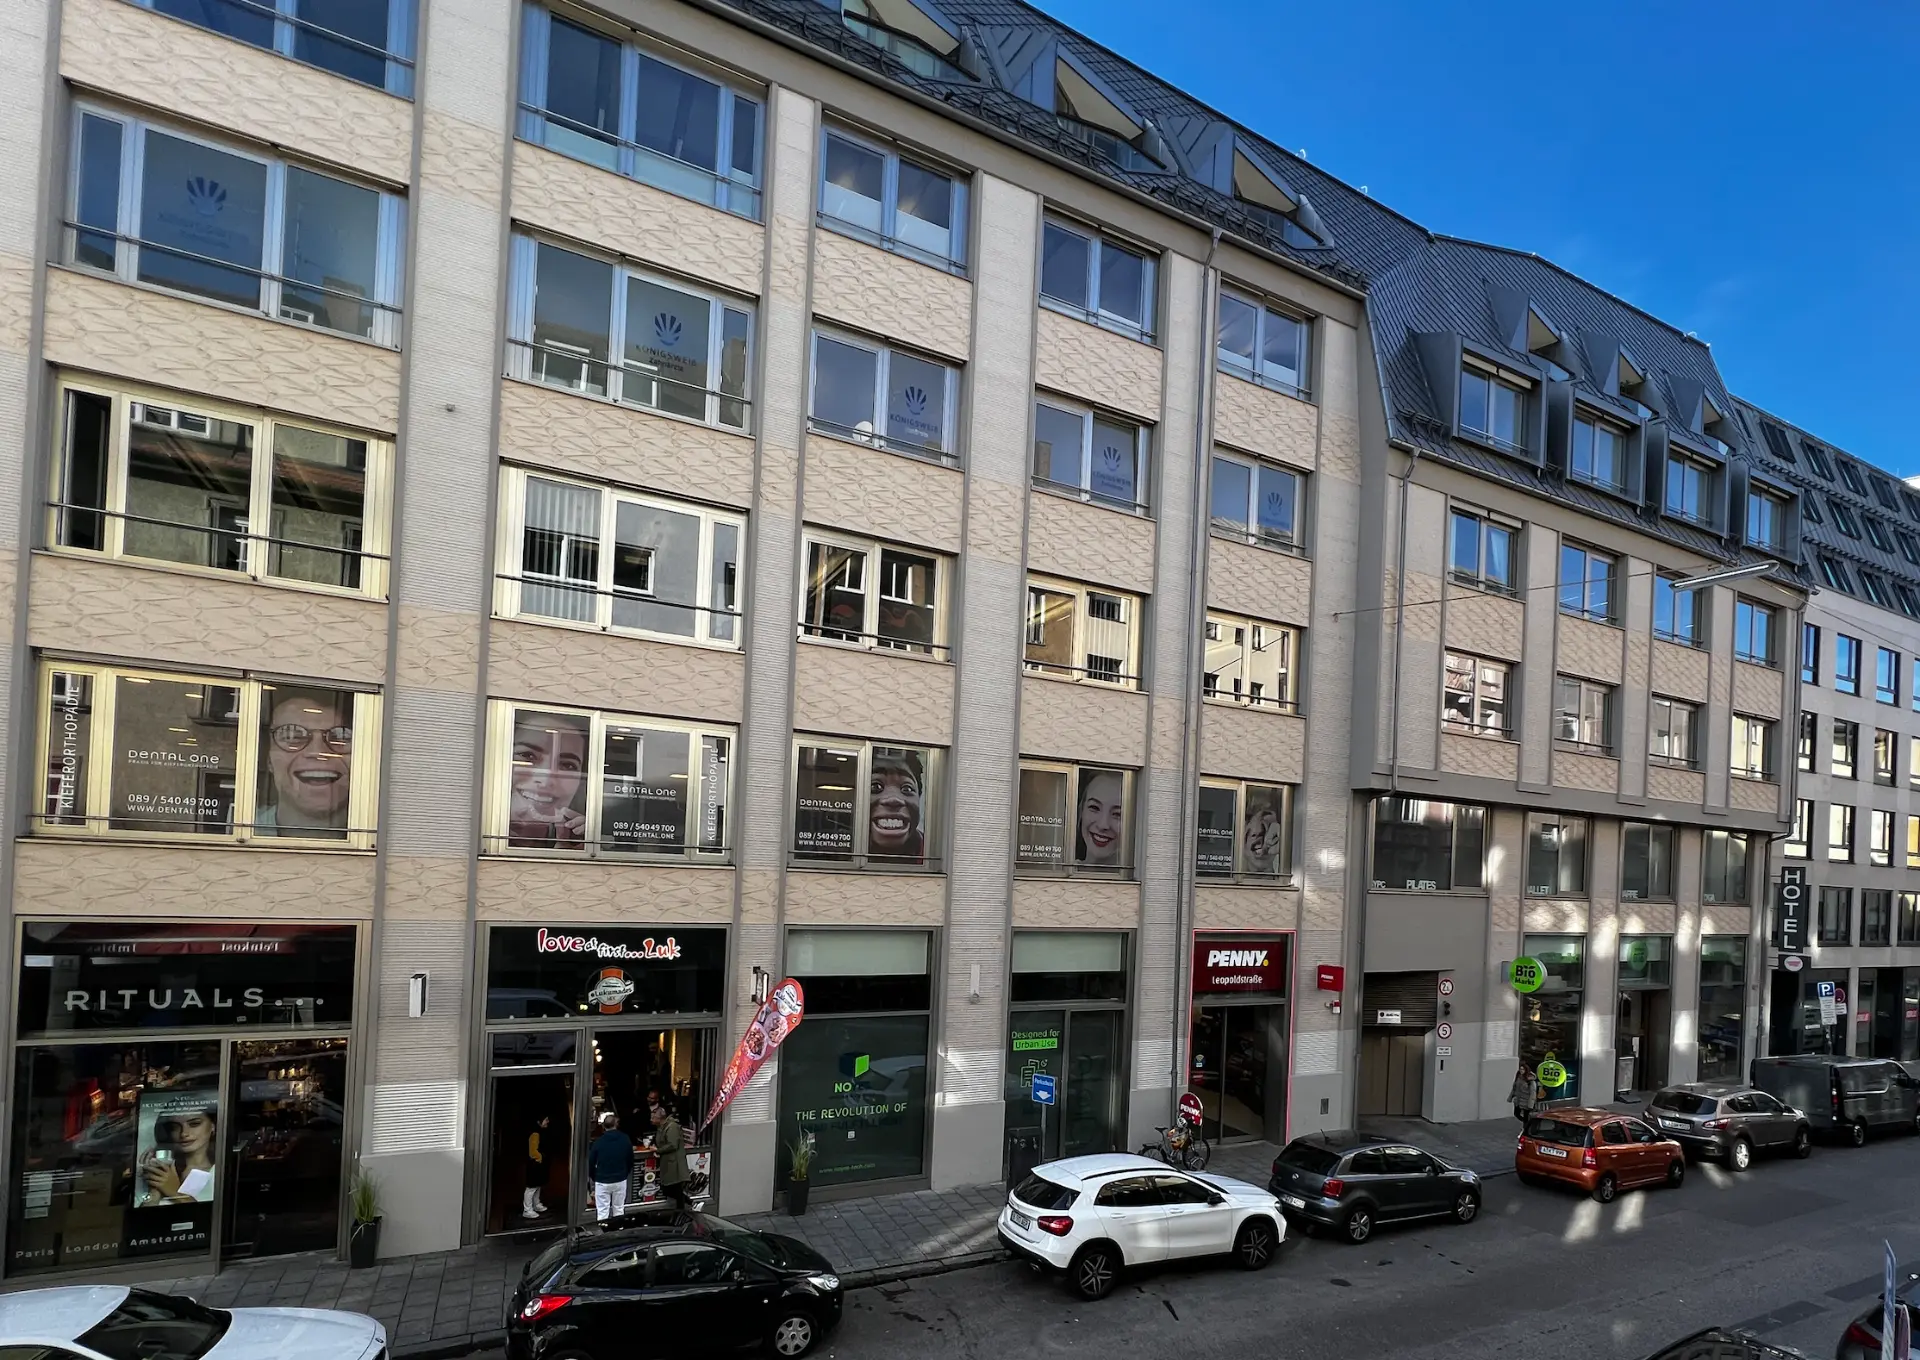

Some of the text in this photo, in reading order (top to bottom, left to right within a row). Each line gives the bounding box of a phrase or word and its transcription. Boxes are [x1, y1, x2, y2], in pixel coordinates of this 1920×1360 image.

[128, 793, 150, 803] 089
[613, 821, 629, 830] 089
[1406, 879, 1437, 890] PILATES
[1782, 870, 1801, 949] HOTEL
[537, 927, 586, 953] love
[584, 937, 598, 952] at
[643, 937, 682, 960] Luk
[1212, 974, 1263, 985] Leopoldstraße
[1514, 977, 1535, 986] Markt
[1821, 984, 1831, 996] P
[1011, 1028, 1060, 1039] Designed for
[1441, 1026, 1448, 1036] 5
[1015, 1039, 1056, 1050] Urban Use
[796, 1102, 908, 1121] THE REVOLUTION OF
[15, 1232, 206, 1259] Paris London Amsterdam
